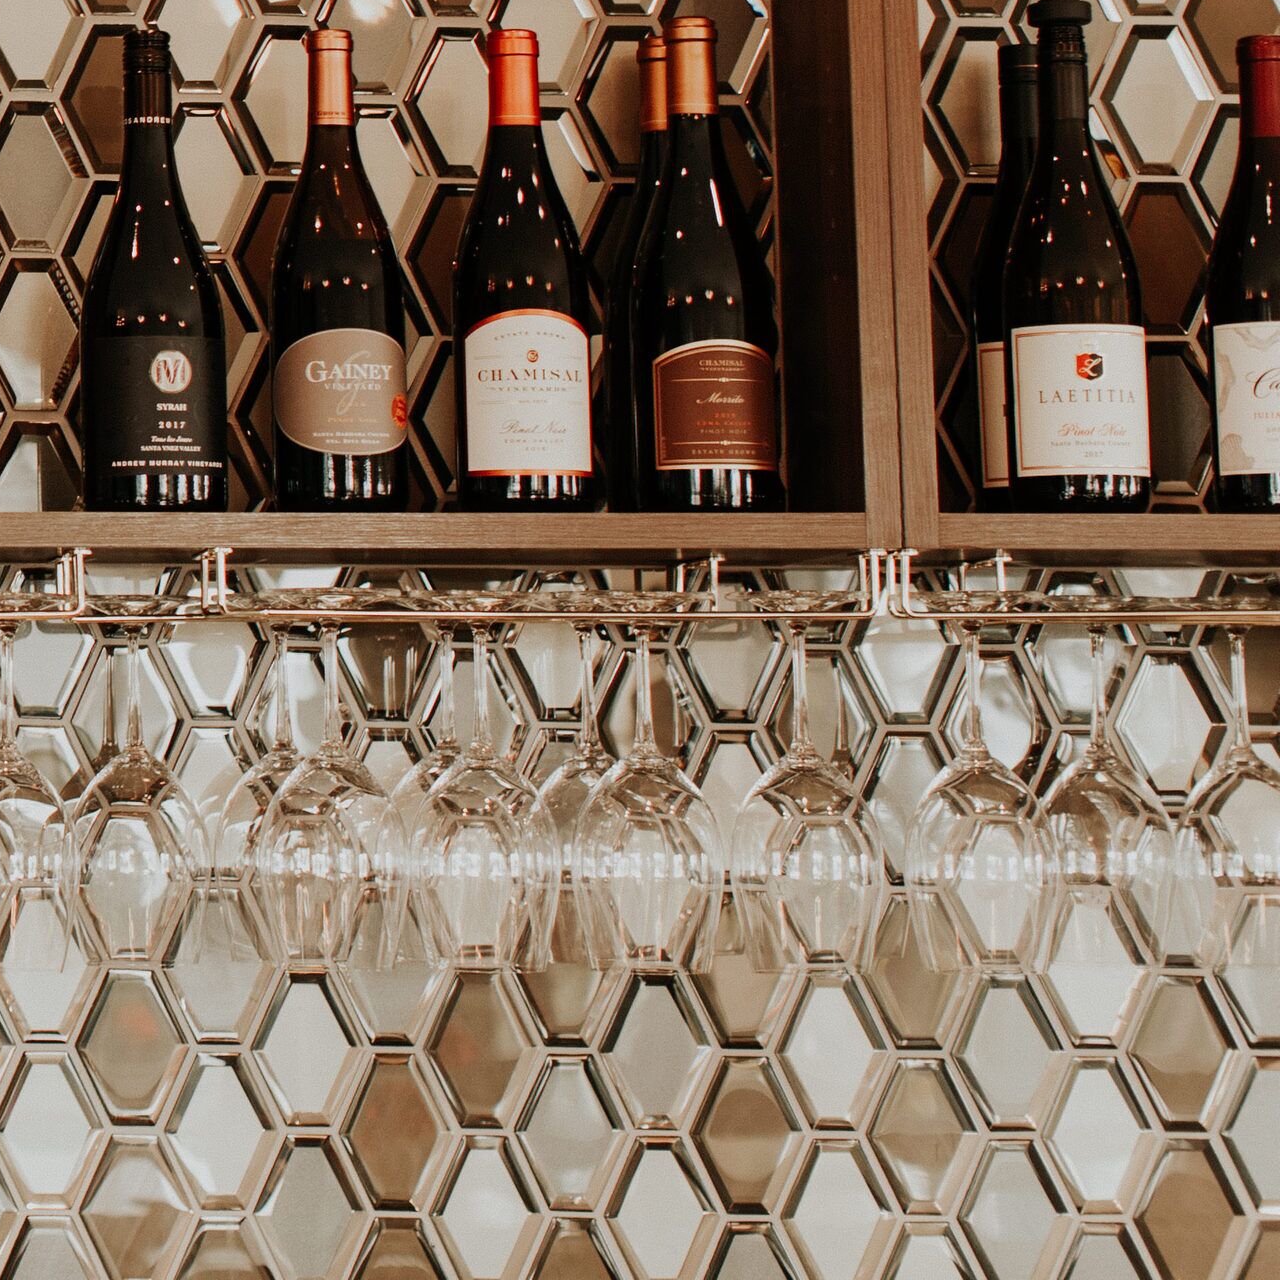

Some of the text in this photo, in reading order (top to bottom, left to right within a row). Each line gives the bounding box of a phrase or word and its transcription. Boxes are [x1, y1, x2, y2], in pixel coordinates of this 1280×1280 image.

[698, 359, 745, 367] CHAMISAL
[304, 360, 393, 383] GAINEY
[476, 369, 583, 383] CHAMISAL
[324, 383, 383, 391] VINEYARD
[1038, 389, 1137, 404] LAETITIA
[156, 402, 188, 412] SYRAH
[158, 421, 187, 430] 2017
[1057, 423, 1097, 437] Pinot
[111, 460, 147, 468] ANDREW
[187, 460, 224, 468] VINEYARDS
